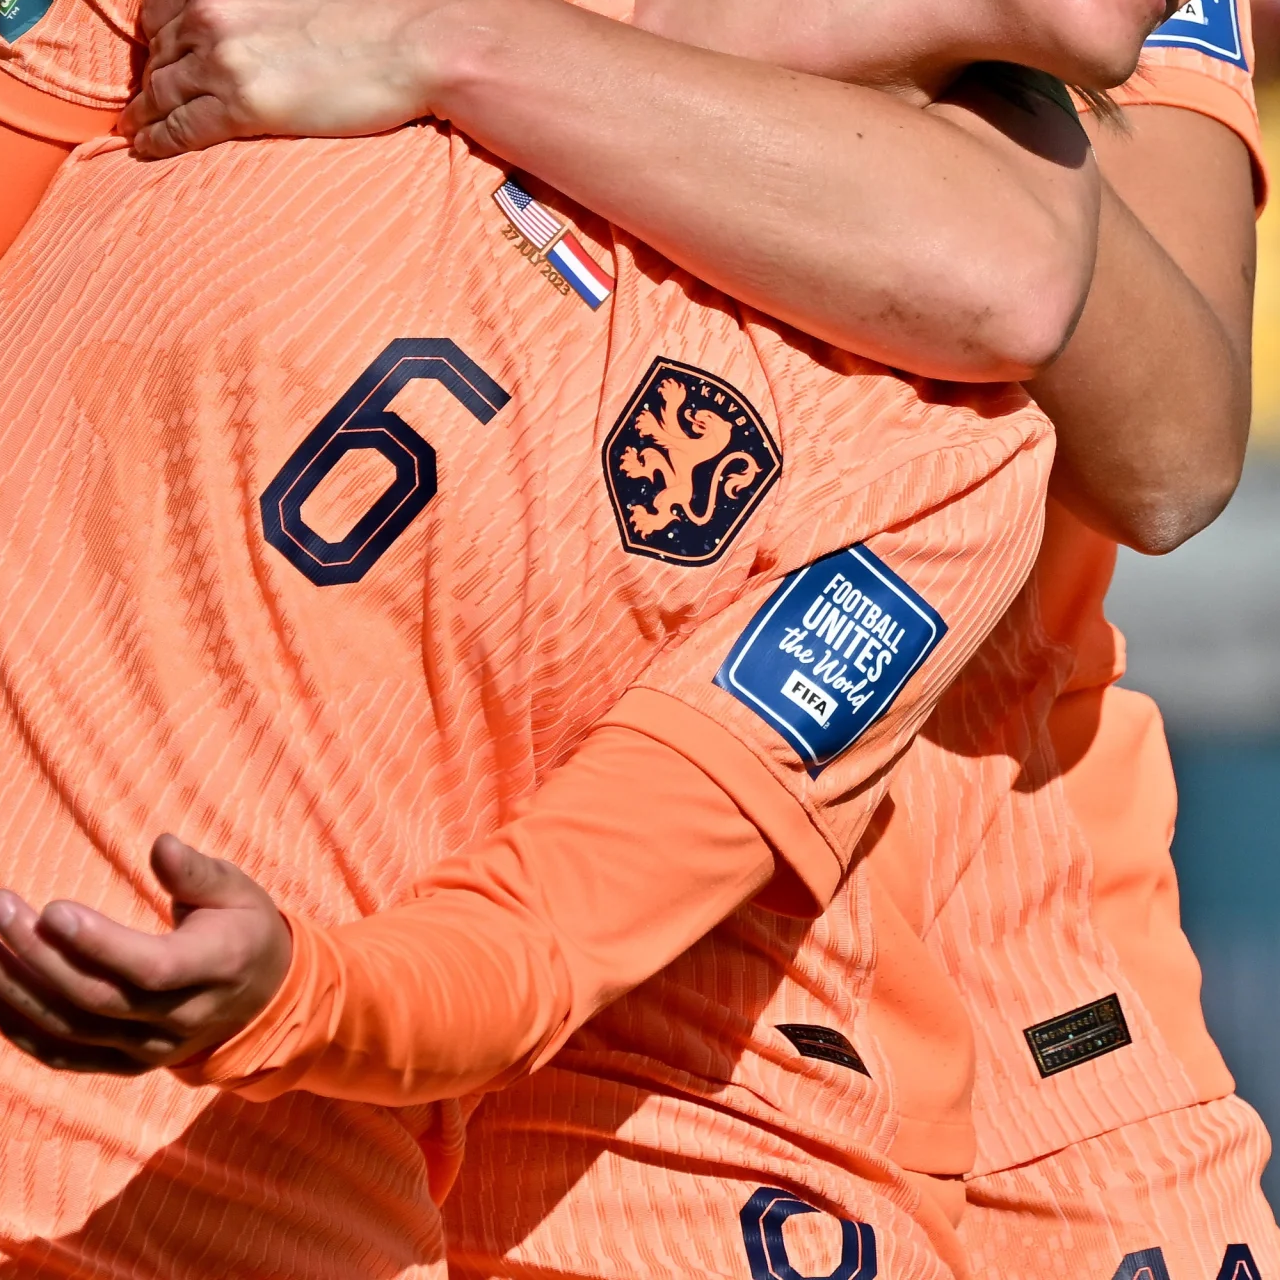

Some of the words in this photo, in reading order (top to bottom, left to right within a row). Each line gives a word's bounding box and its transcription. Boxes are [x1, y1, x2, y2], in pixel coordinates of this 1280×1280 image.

[501, 224, 519, 241] 27
[514, 235, 546, 267] JULY
[540, 264, 571, 296] 2023
[701, 385, 747, 426] KNVB
[260, 338, 512, 587] 6
[802, 595, 892, 682] UNITES
[823, 573, 906, 654] FOOTBALL
[778, 626, 815, 664] the
[813, 650, 874, 714] World
[791, 680, 827, 717] FIFA
